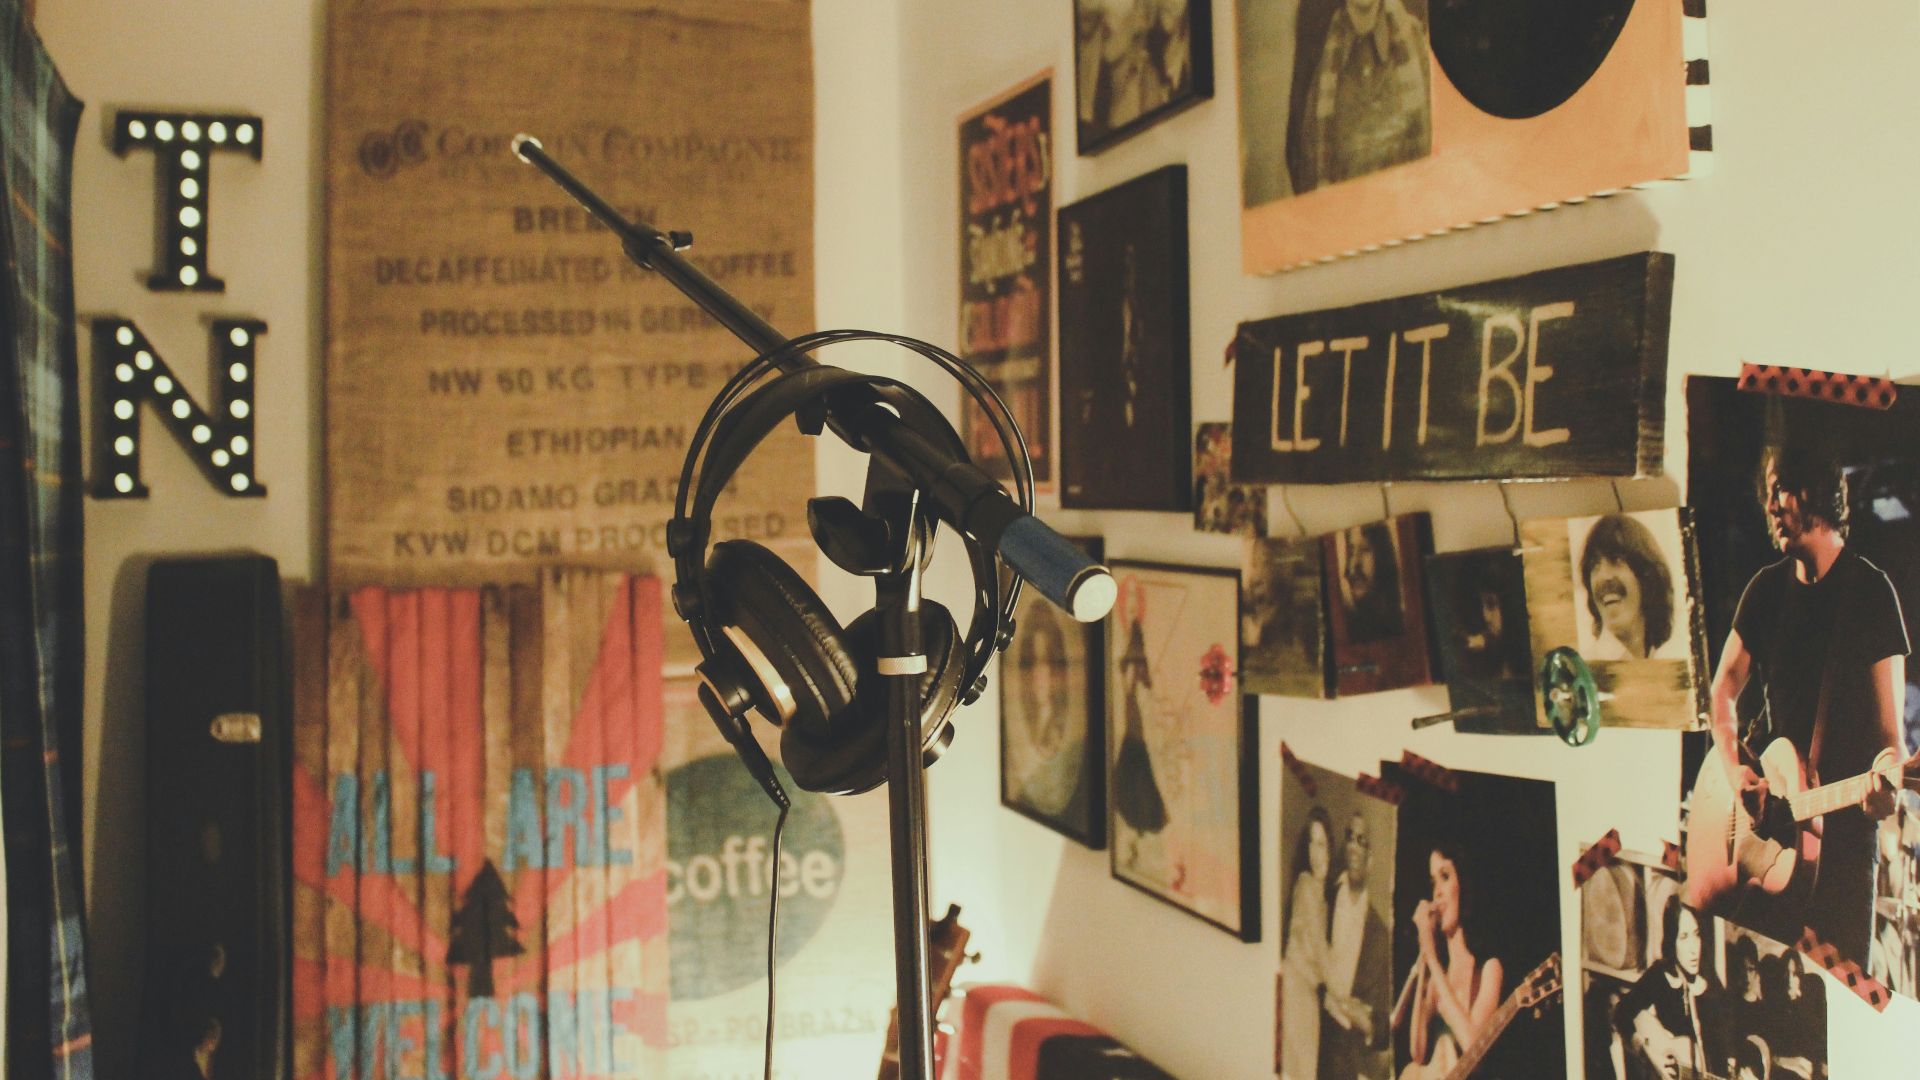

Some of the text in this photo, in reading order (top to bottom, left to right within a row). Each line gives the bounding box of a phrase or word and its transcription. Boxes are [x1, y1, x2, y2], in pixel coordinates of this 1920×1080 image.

[106, 110, 263, 291] T
[514, 206, 657, 233] BREMN
[375, 256, 611, 285] DECAFFEINATED
[420, 309, 596, 336] PROCESSED
[641, 302, 777, 333] GERMY
[428, 368, 482, 396] NW
[546, 365, 594, 393] KG
[620, 361, 706, 390] TYPE
[1271, 300, 1575, 452] LET IT BE
[86, 317, 268, 499] N
[506, 425, 684, 457] ETHIOPIAN
[446, 483, 578, 513] SIDAMO
[393, 512, 786, 558] KVW DCM PROCSED
[326, 763, 633, 877] ALL ARE
[667, 834, 835, 905] coffee
[326, 987, 635, 1080] WELCOME
